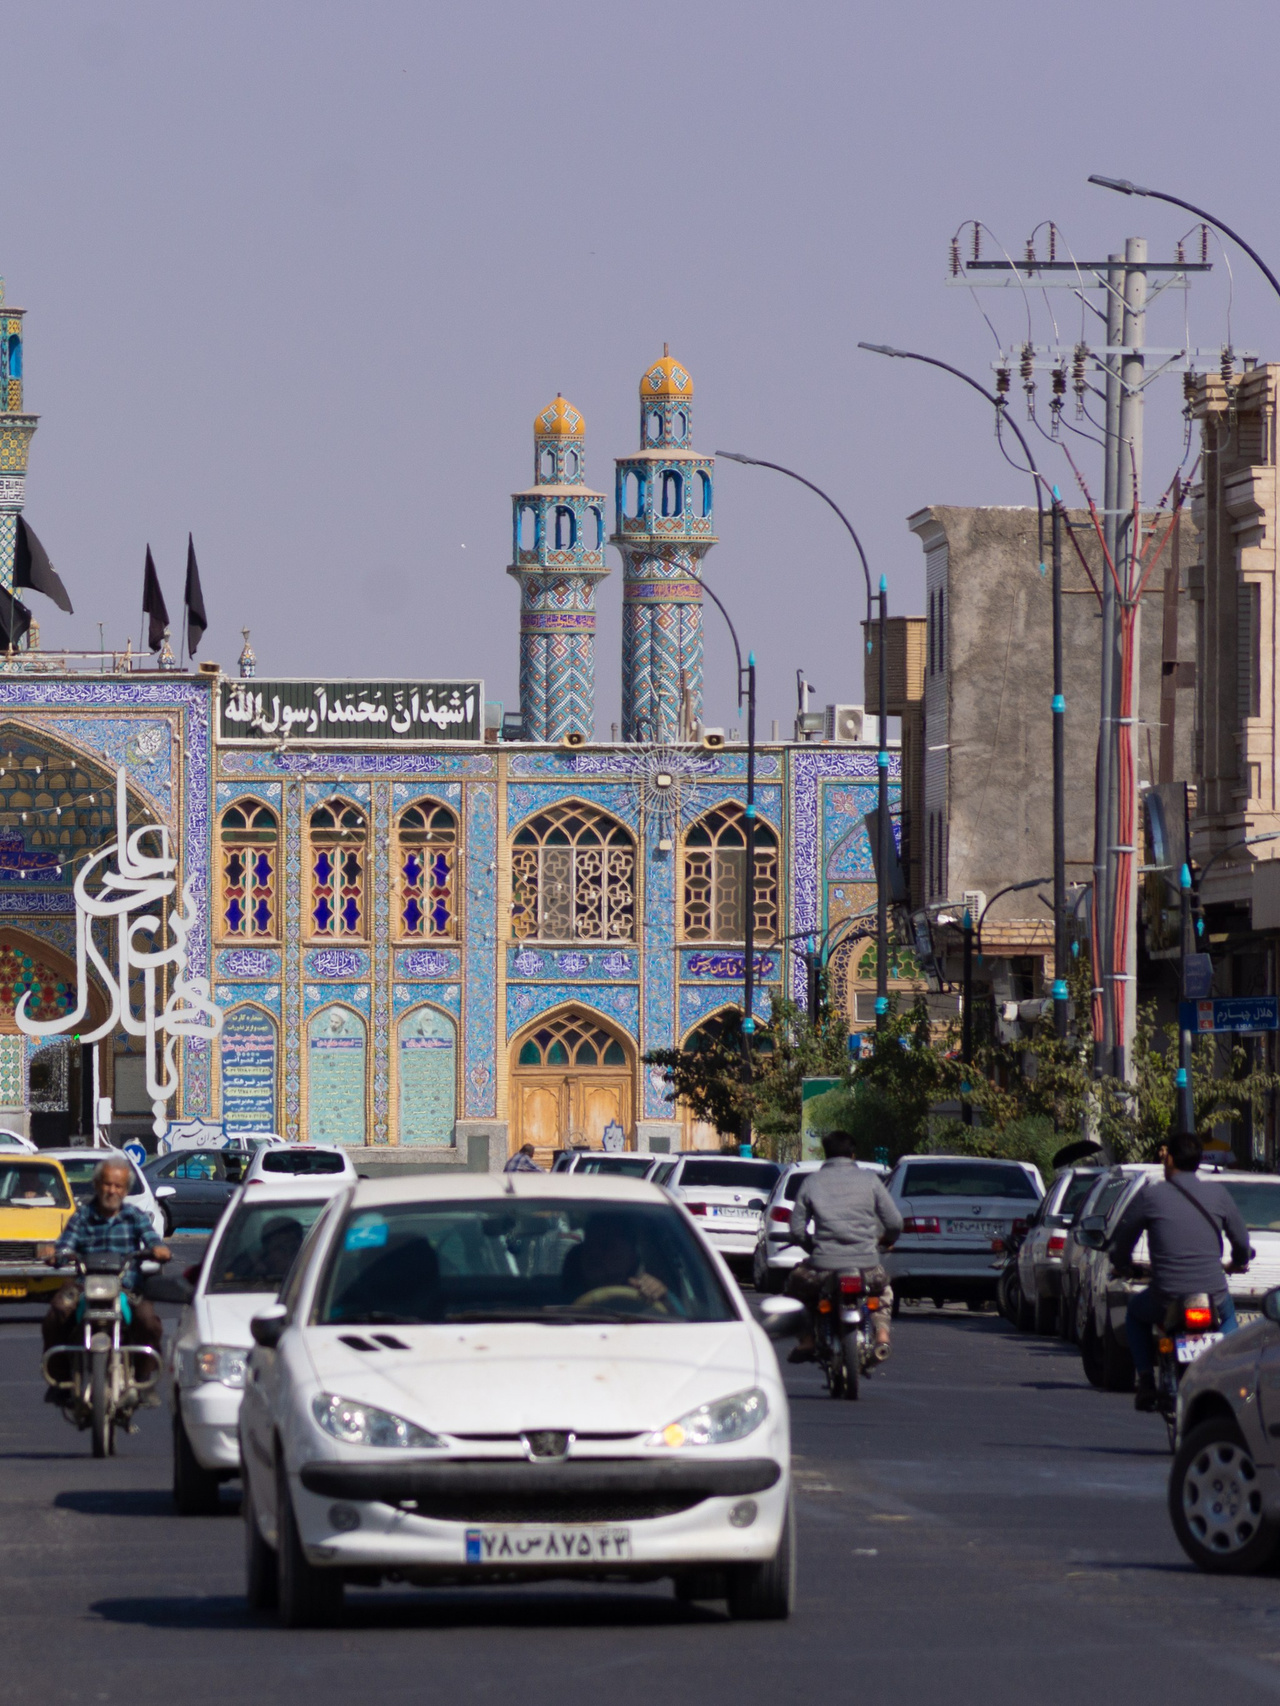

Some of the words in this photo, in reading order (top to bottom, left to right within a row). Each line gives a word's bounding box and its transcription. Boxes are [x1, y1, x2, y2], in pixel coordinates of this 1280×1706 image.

[262, 695, 318, 733] رسول
[1217, 1008, 1251, 1023] چهارم
[1253, 1007, 1273, 1021] هلال
